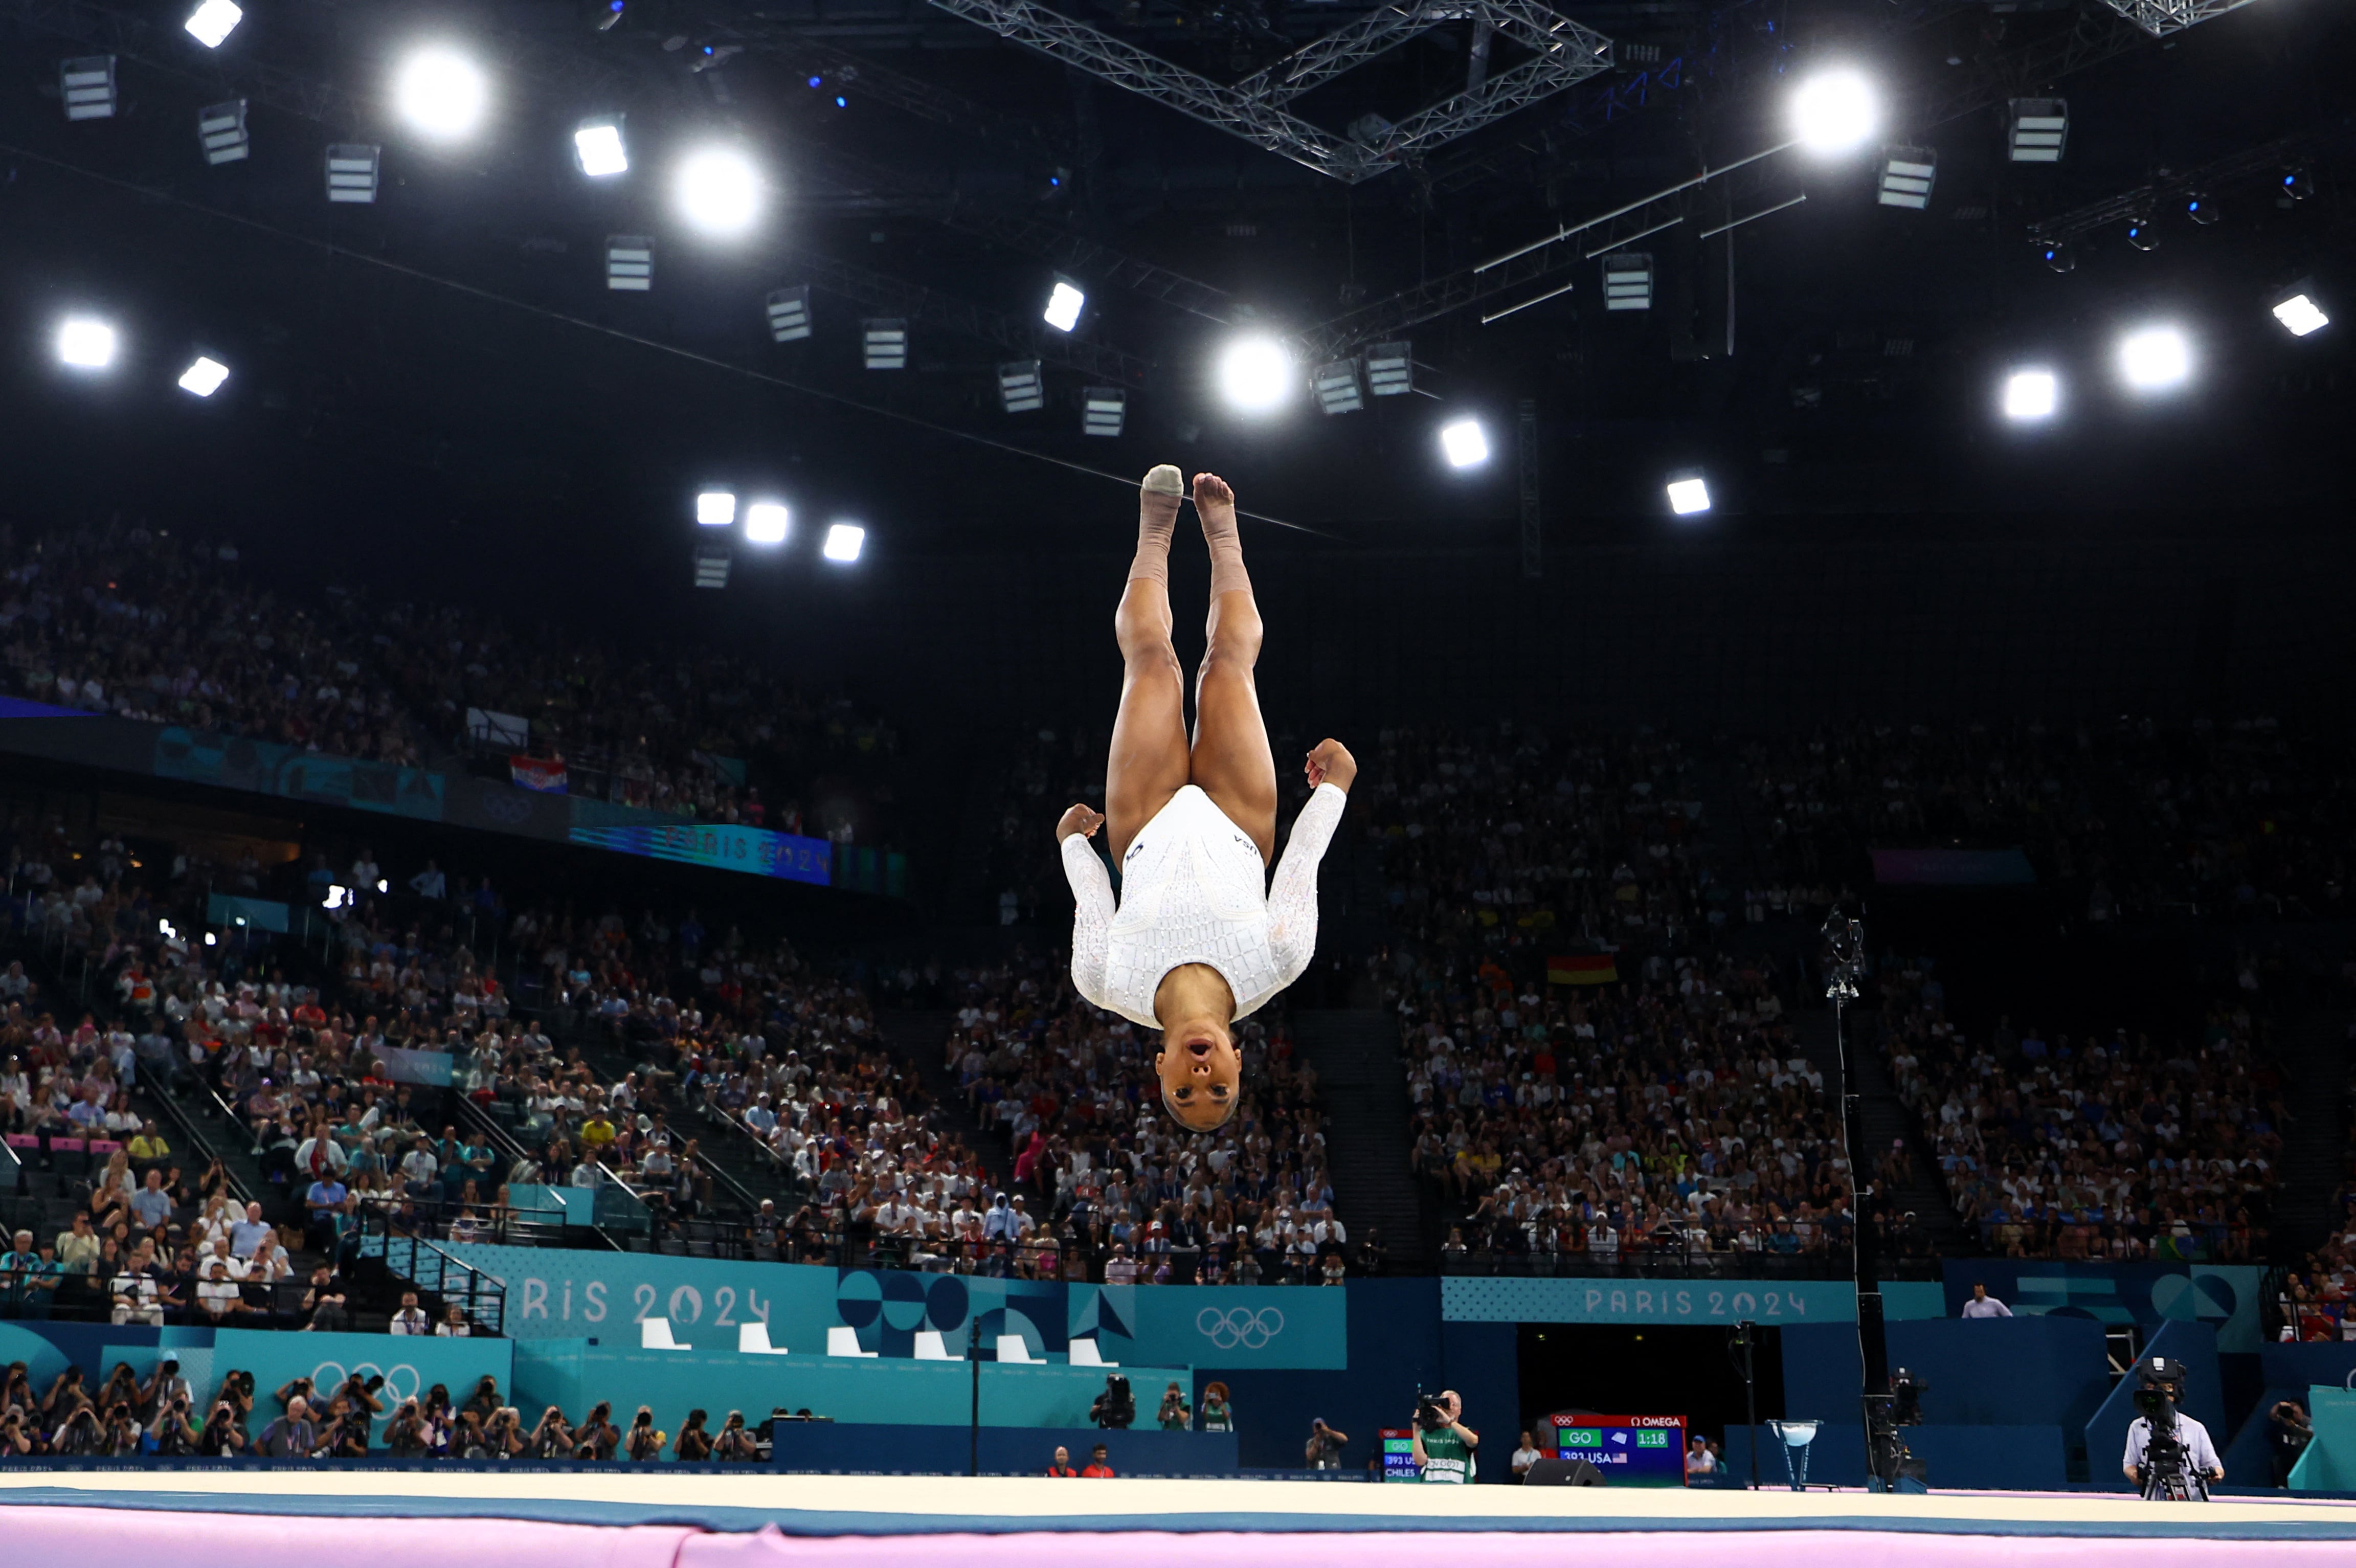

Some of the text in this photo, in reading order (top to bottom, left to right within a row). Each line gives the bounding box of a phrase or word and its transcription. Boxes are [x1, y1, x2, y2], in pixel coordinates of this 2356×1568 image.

[1586, 1289, 1805, 1316] PARIS 2024
[1642, 1417, 1681, 1427] OMEGA
[1569, 1431, 1592, 1444] GO
[1639, 1433, 1666, 1445] 1:18
[1392, 1442, 1408, 1451] GO
[1388, 1456, 1403, 1465] 393
[1588, 1452, 1612, 1464] USA
[1385, 1468, 1416, 1477] CHILES
